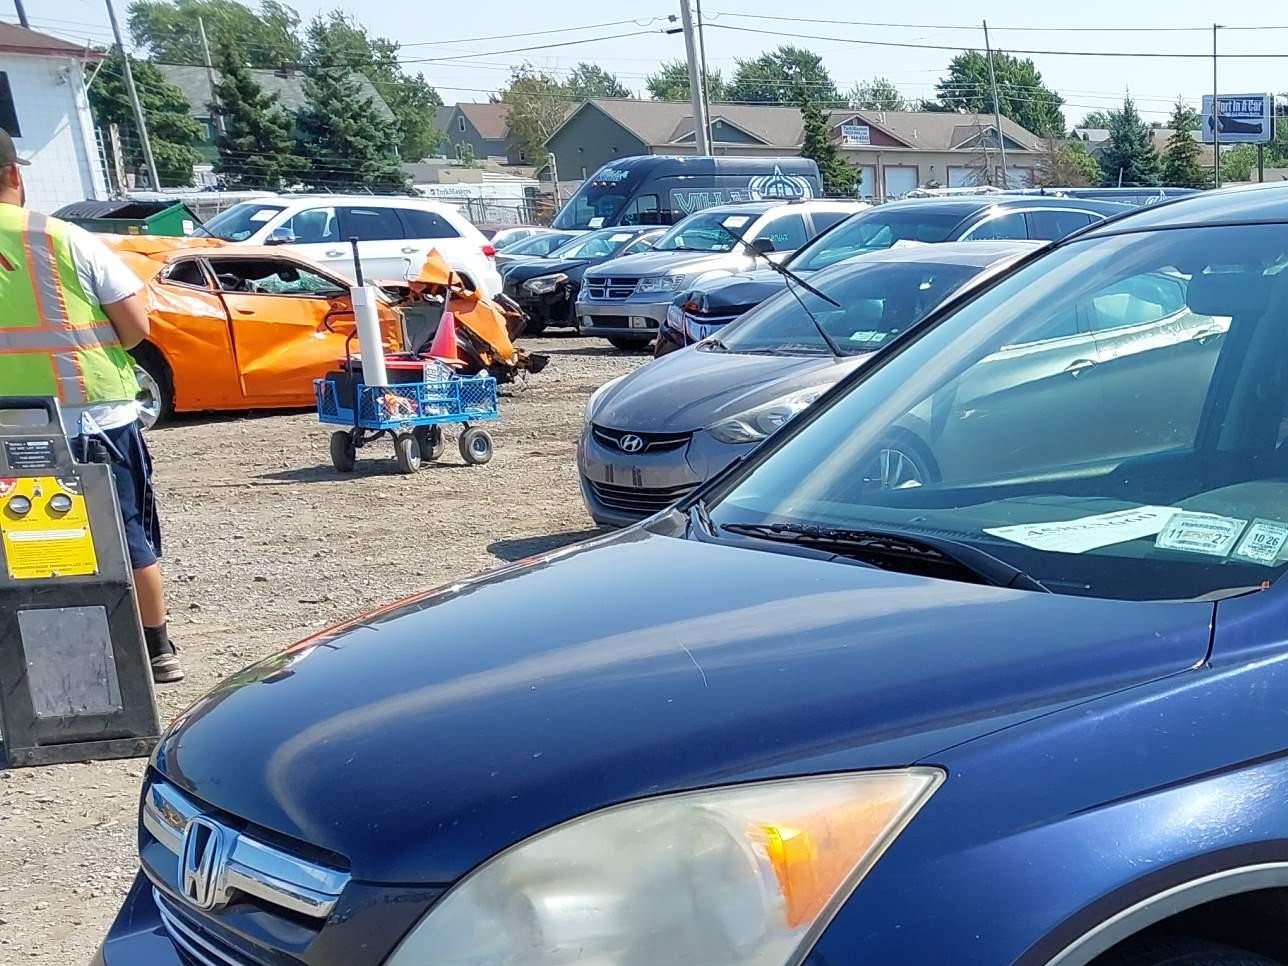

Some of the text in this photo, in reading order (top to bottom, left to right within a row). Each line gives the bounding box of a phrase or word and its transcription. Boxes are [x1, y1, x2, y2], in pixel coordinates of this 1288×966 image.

[1168, 528, 1183, 539] 11
[1211, 533, 1230, 545] 27
[1254, 533, 1280, 547] 10 26
